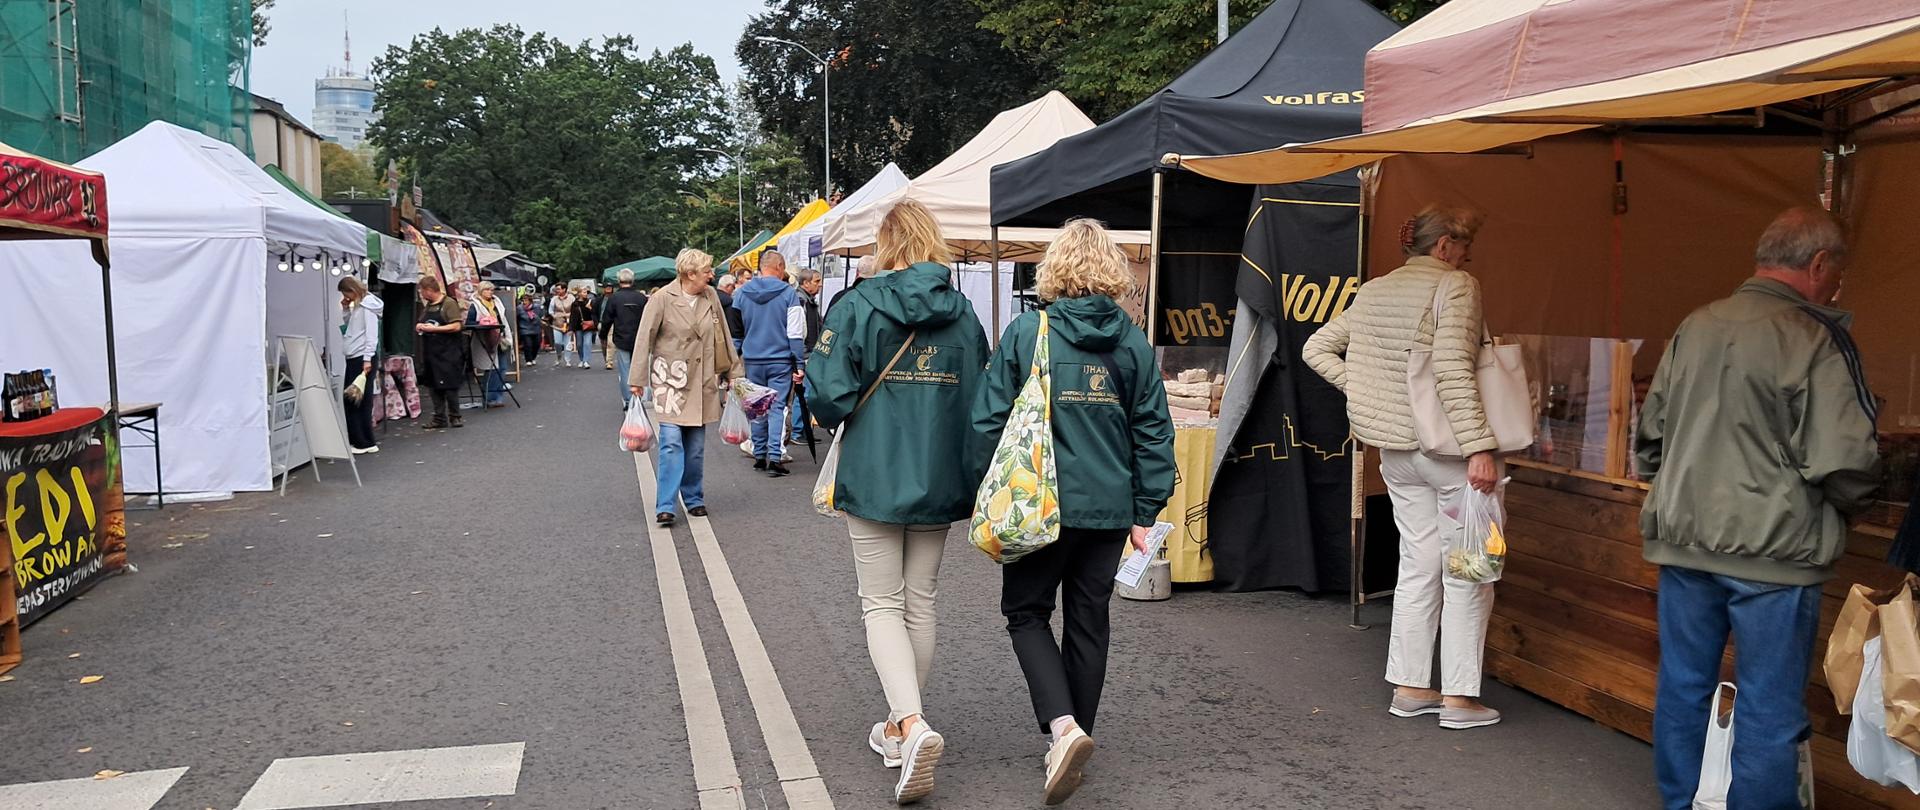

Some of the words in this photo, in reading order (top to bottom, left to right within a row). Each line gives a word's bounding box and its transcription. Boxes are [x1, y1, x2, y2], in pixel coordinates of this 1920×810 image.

[1281, 273, 1359, 323] Volf
[6, 466, 97, 561] EDI
[14, 532, 97, 590] BROWAR
